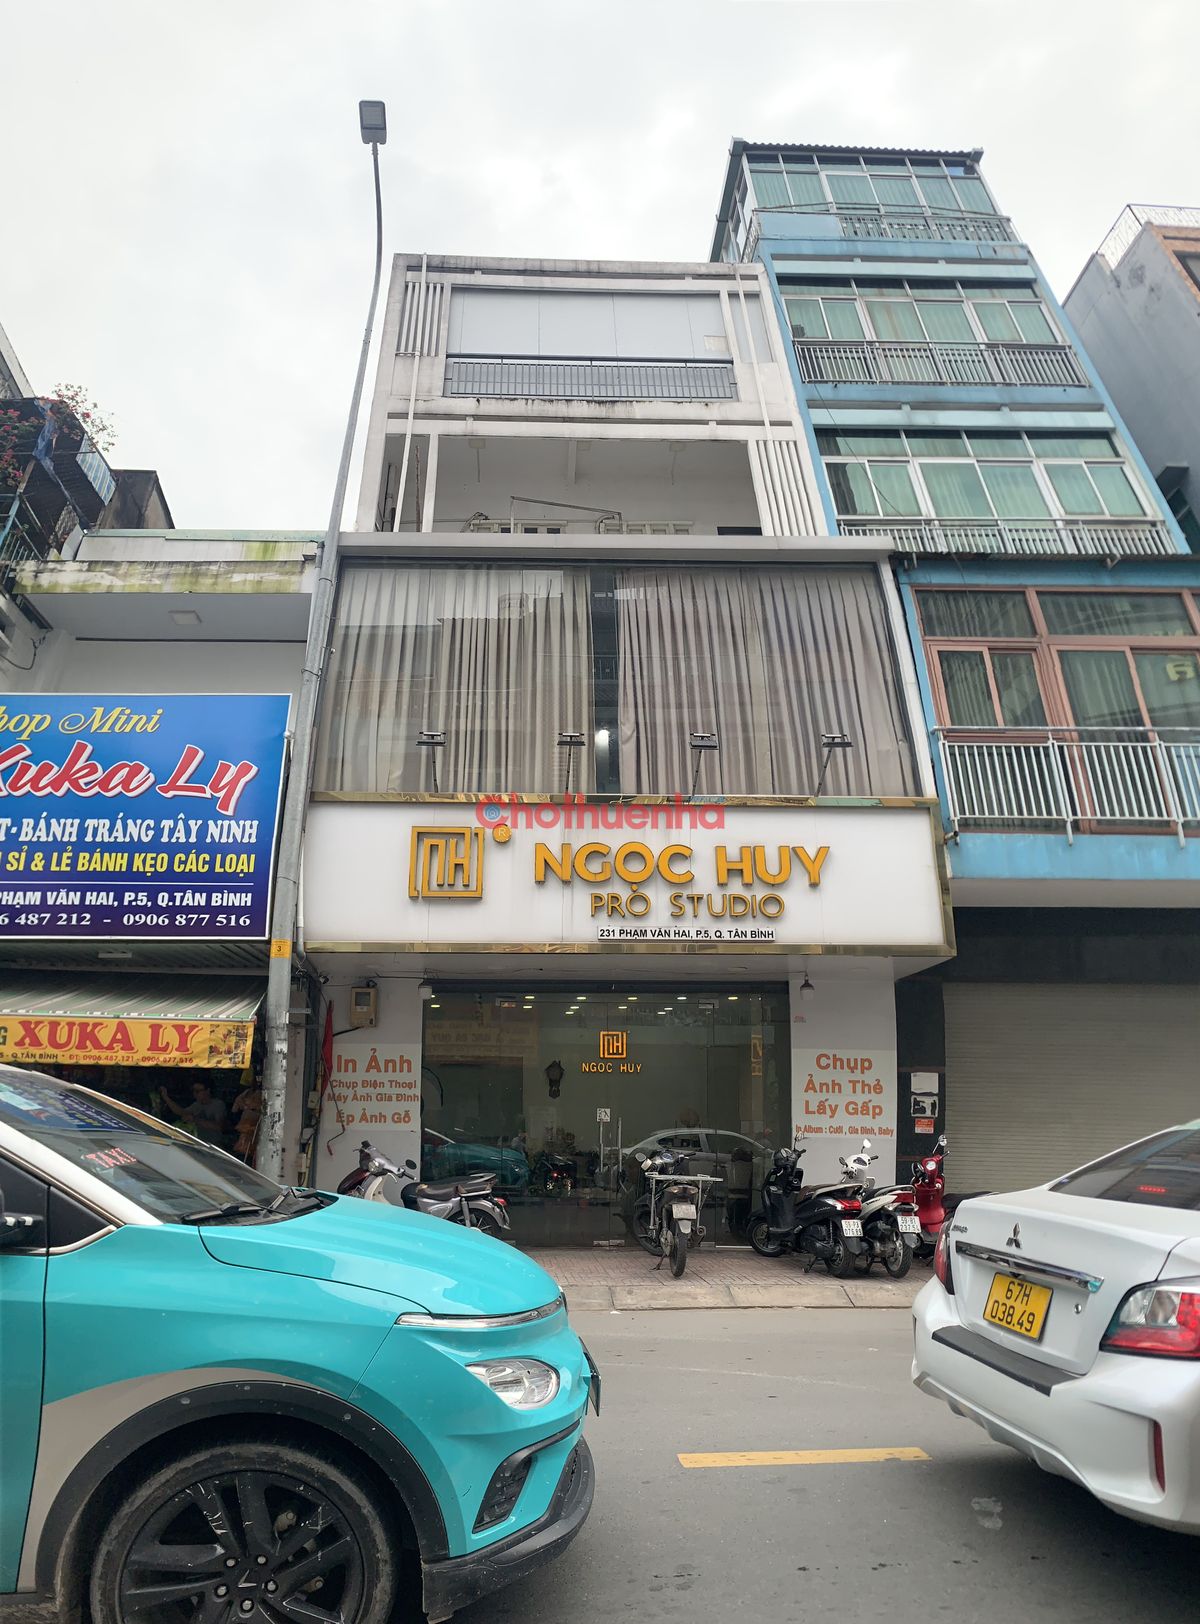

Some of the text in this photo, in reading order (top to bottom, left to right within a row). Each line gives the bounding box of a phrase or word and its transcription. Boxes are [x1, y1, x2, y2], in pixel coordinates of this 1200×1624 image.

[0, 706, 163, 740] hop Mini
[155, 743, 261, 816] Ly
[84, 813, 155, 844] TRÁNG
[160, 812, 203, 844] TÂY
[206, 819, 260, 845] NINH
[30, 853, 46, 872] &
[51, 846, 73, 873] LẺ
[77, 847, 129, 873] BÁNH
[132, 853, 169, 877] KẸO
[173, 849, 210, 874] CÁC
[214, 853, 256, 878] LOẠI
[534, 841, 832, 892] NGỌC HUY
[46, 888, 80, 907] VĂN
[84, 891, 119, 909] HAI,
[123, 892, 152, 909] P.5,
[157, 888, 207, 909] Q.TÂN
[211, 889, 253, 908] BÌNH
[590, 891, 786, 918] PRO STUDIO
[15, 913, 51, 927] 487
[57, 913, 92, 927] 212
[123, 913, 170, 928] 0906
[175, 914, 210, 928] 877
[215, 914, 251, 928] 516
[600, 927, 774, 941] 231 PHẠM VĂN HAI, P.5, Q. TÂN BÌNH
[14, 1020, 137, 1053] XUKA
[146, 1023, 204, 1055] LY
[336, 1048, 412, 1073] In Ảnh
[619, 1063, 642, 1073] HUY
[815, 1053, 873, 1074] Chụp
[803, 1073, 884, 1095] Ảnh Thẻ
[351, 1090, 372, 1102] Ảnh
[375, 1093, 393, 1102] Gia
[359, 1107, 387, 1124] Ảnh
[391, 1109, 412, 1124] Gỗ
[804, 1098, 884, 1119] Lấy Gấp
[802, 1124, 823, 1135] Album
[1005, 1280, 1033, 1306] 67H
[990, 1300, 1036, 1333] 038.49
